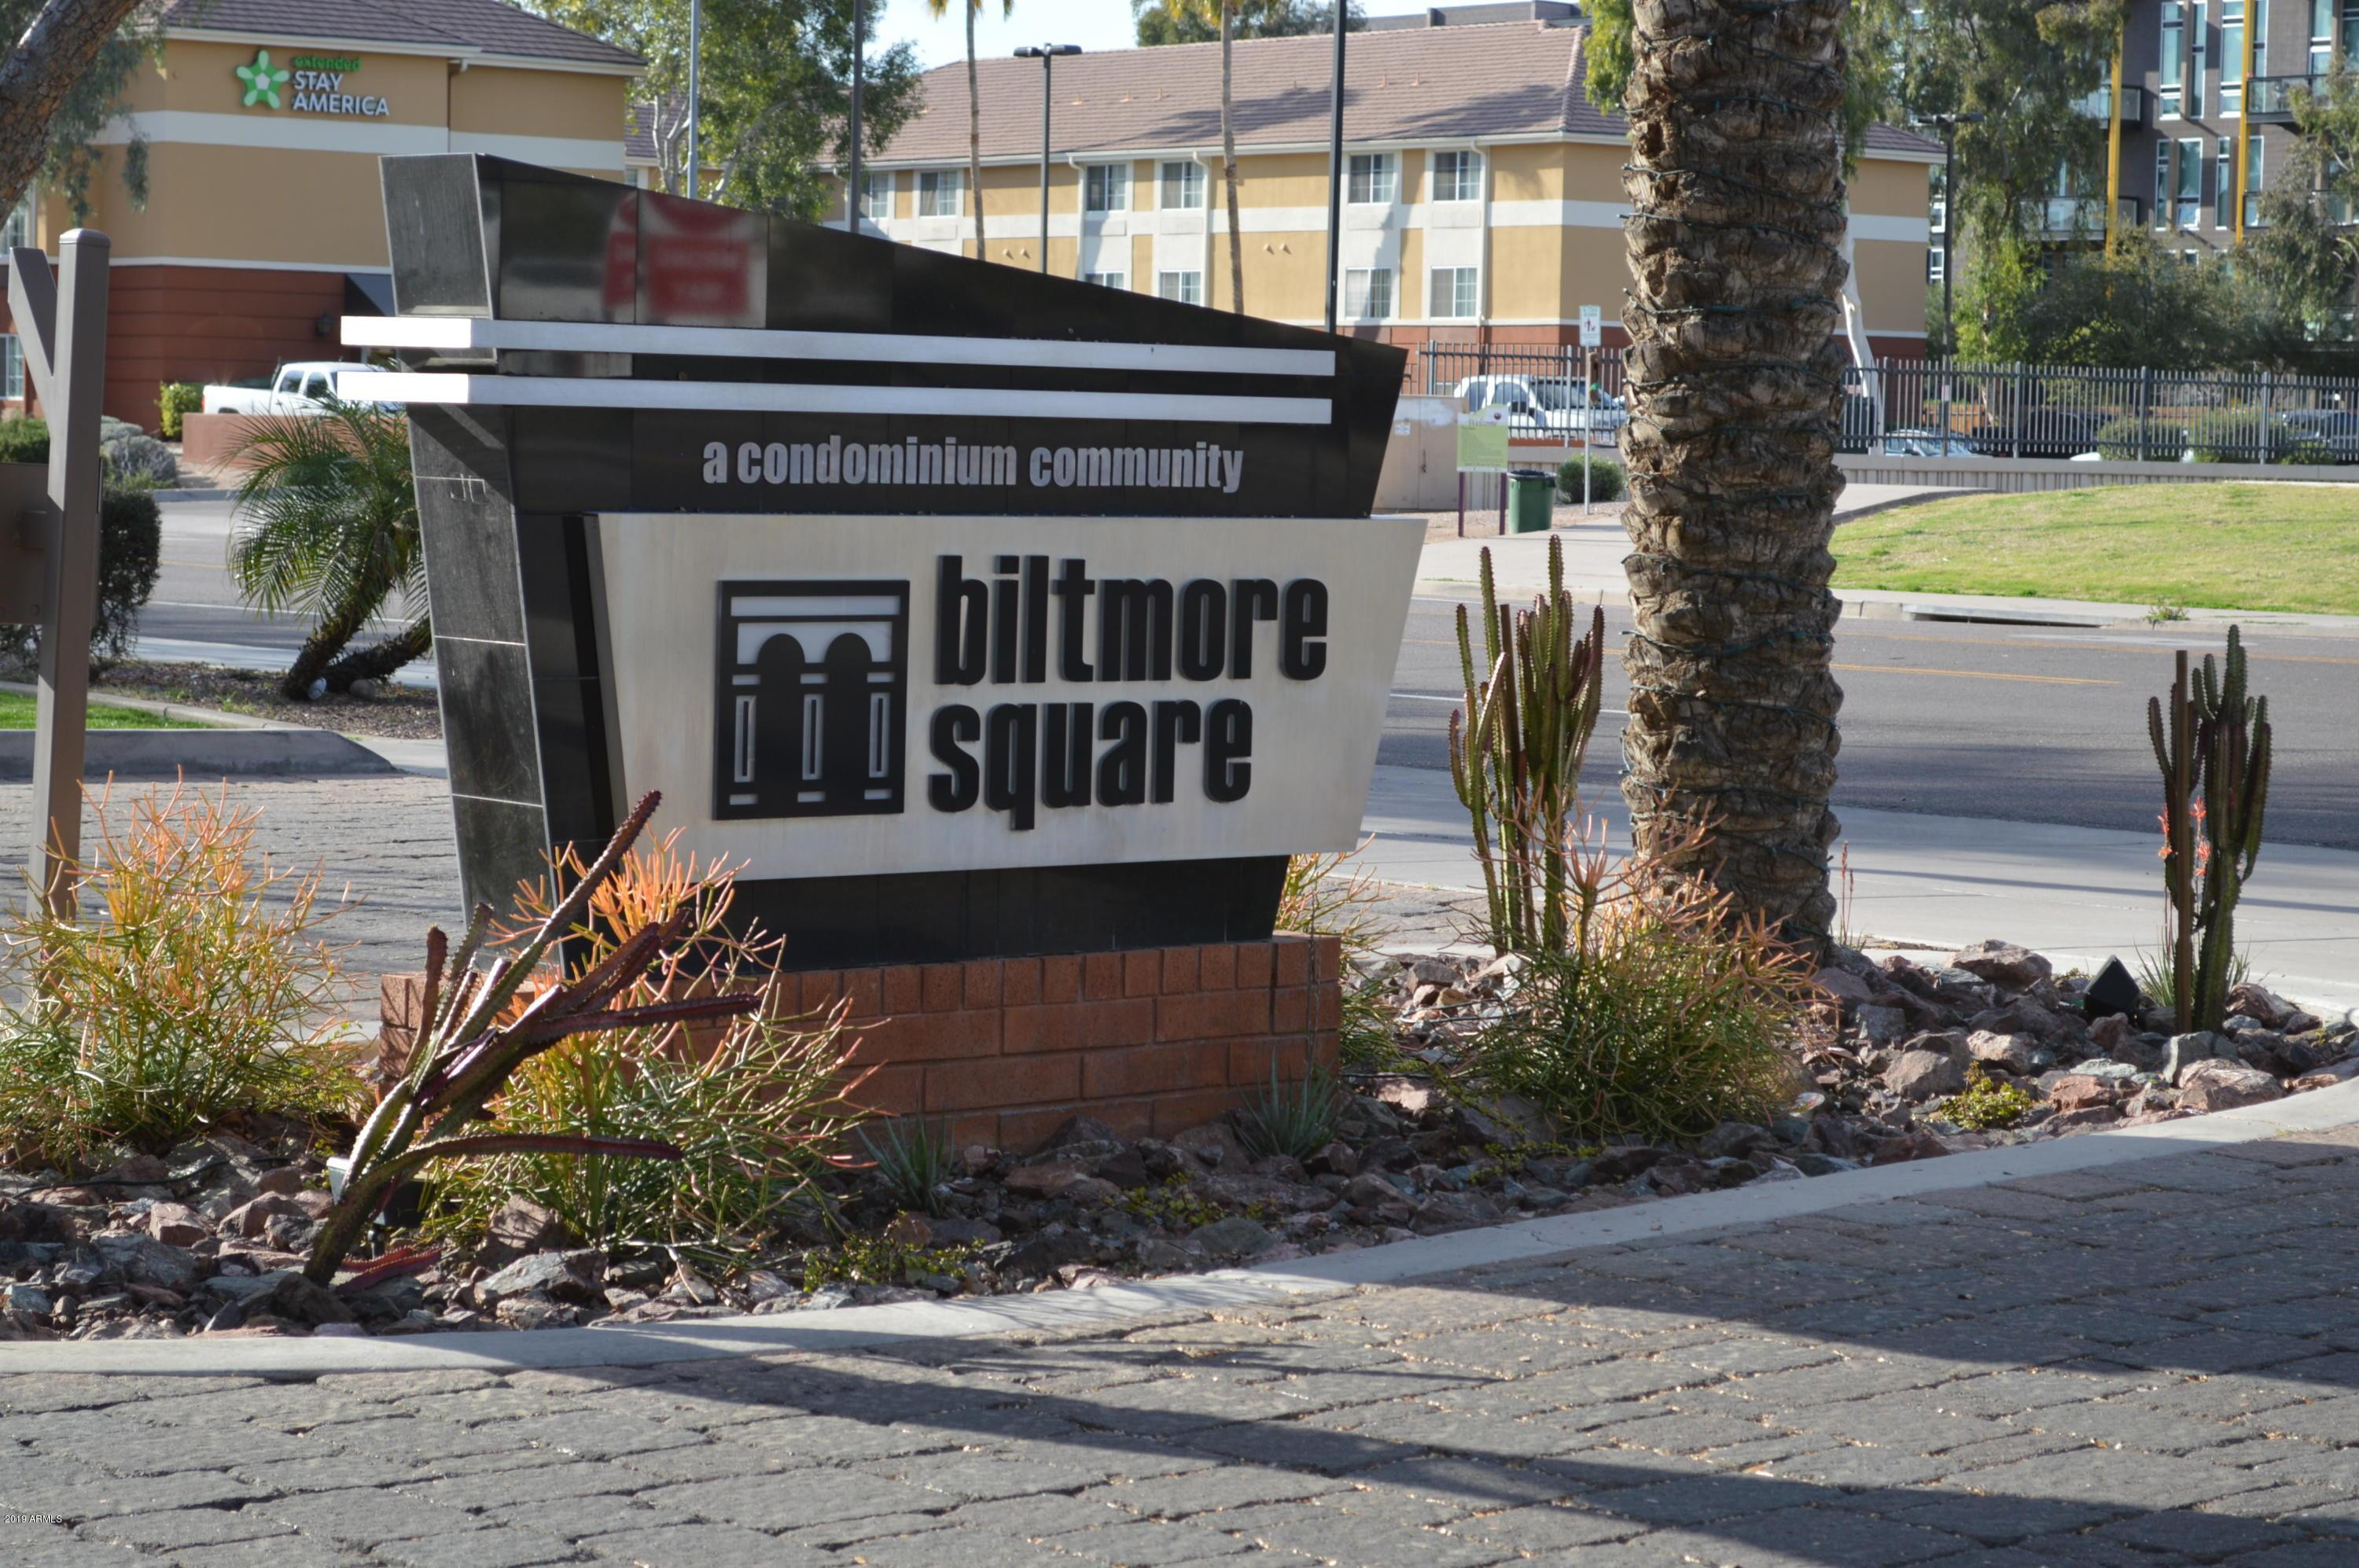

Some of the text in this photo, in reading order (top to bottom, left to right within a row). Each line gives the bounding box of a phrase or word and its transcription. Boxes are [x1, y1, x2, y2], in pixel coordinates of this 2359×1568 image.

[293, 55, 362, 72] extended
[293, 70, 344, 92] STAY
[293, 92, 390, 116] AMERICA
[703, 435, 1244, 493] a condominium community
[934, 555, 1329, 686] biltmore
[928, 698, 1253, 830] square
